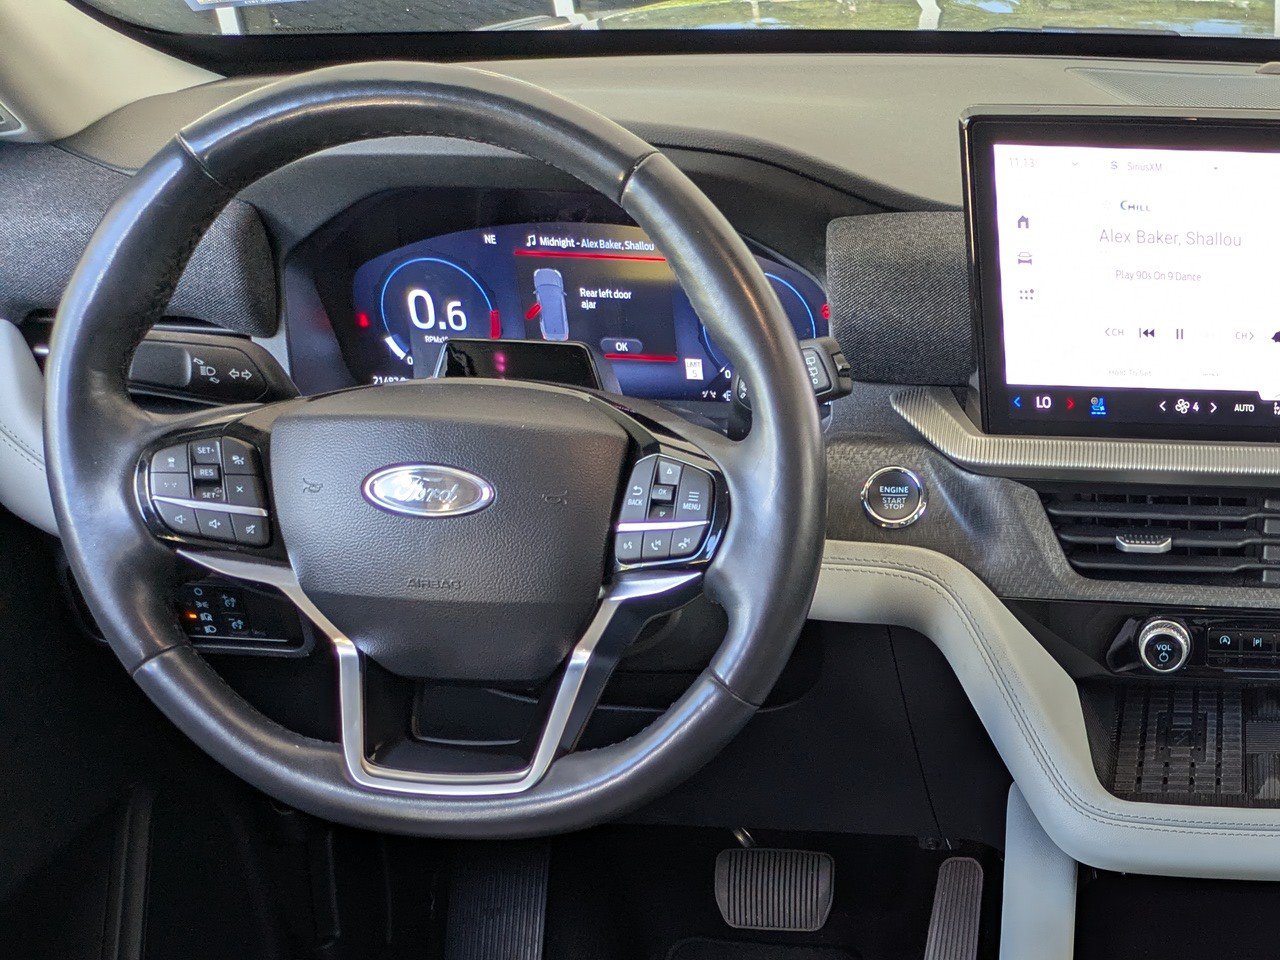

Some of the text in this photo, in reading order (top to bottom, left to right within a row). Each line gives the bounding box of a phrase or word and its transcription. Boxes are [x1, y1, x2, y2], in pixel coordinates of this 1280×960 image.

[484, 234, 497, 245] NE
[1099, 229, 1242, 247] Alex Baker, Shallou
[539, 237, 576, 249] Midnight
[581, 239, 599, 249] Alex
[599, 239, 624, 251] Baker,
[624, 241, 655, 252] Shallou
[1115, 269, 1134, 282] Play
[580, 288, 632, 300] Rear left door
[407, 288, 468, 331] 0.6
[581, 300, 597, 310] ajar
[615, 341, 629, 352] OK
[406, 356, 414, 366] 0
[724, 369, 732, 379] 0
[1036, 396, 1052, 409] LO
[1192, 402, 1200, 412] 4
[1234, 403, 1255, 413] AUTO
[879, 485, 909, 494] ENGINE
[682, 502, 701, 511] MENU
[1156, 644, 1172, 652] VOL
